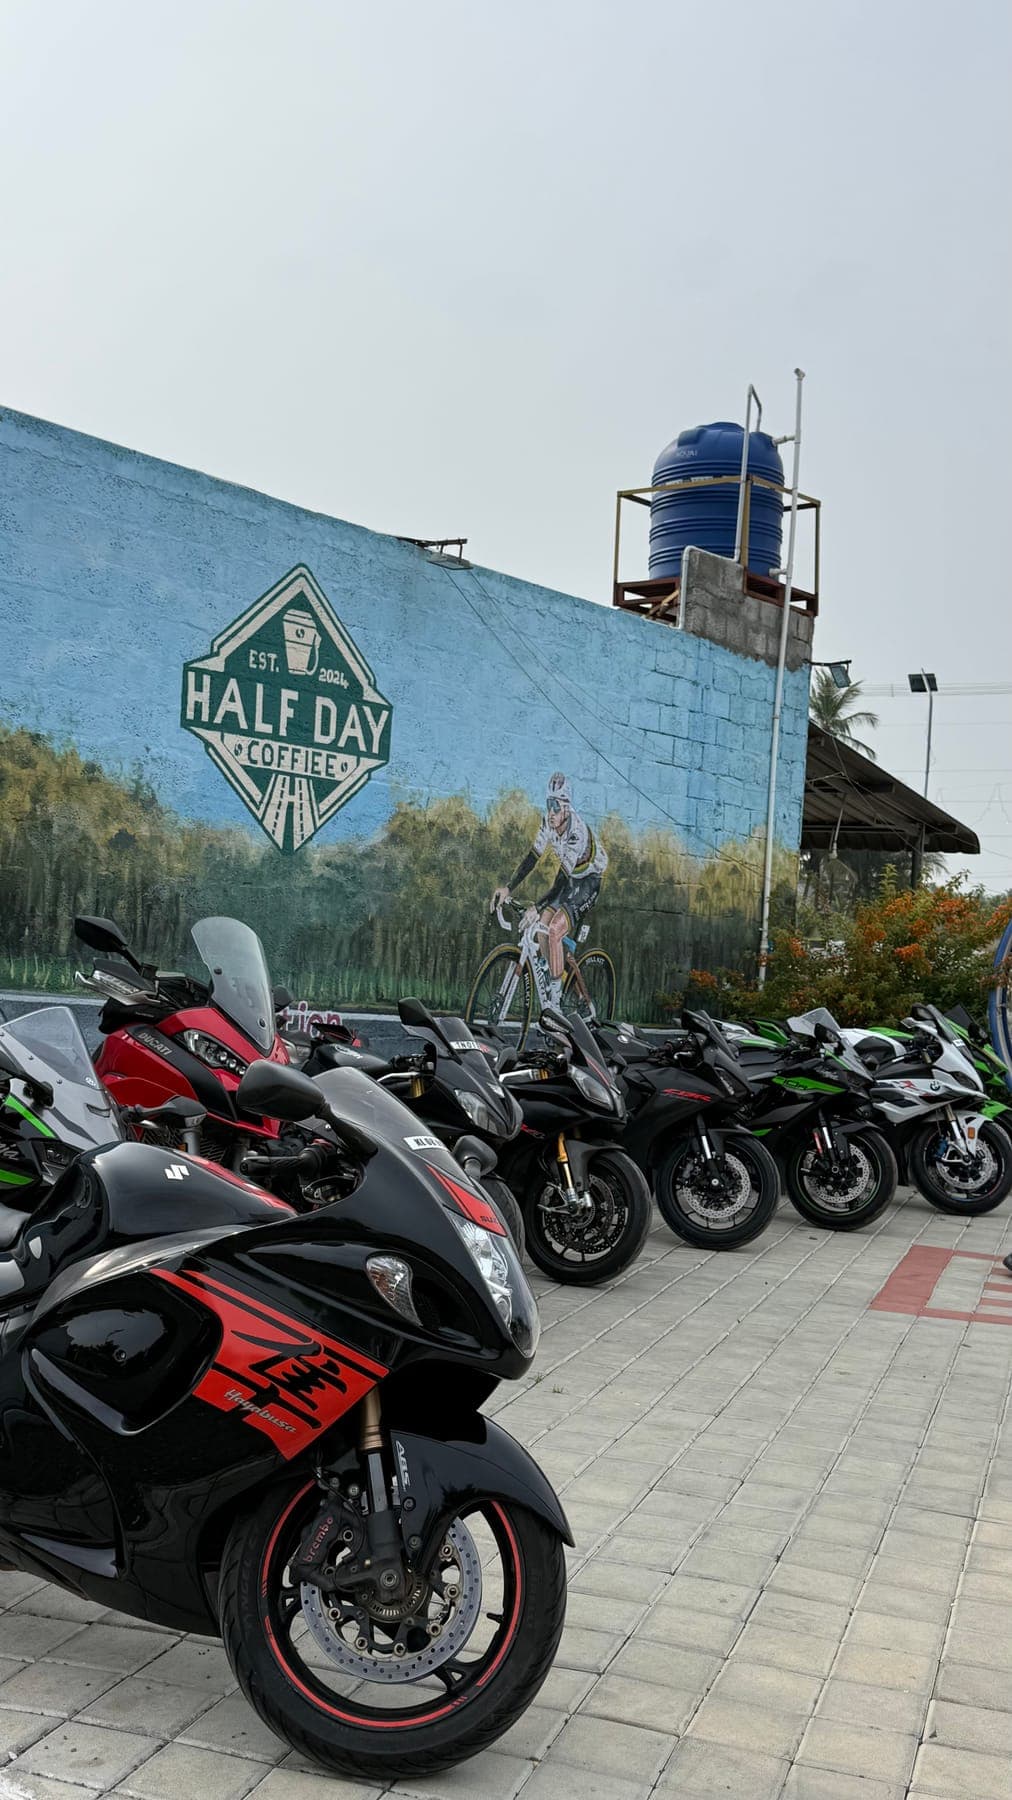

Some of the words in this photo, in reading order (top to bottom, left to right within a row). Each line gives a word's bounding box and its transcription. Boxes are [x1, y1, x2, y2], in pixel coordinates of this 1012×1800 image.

[249, 649, 280, 673] EST.
[318, 667, 349, 689] 2024
[186, 671, 299, 736] HALF
[313, 696, 389, 754] DAY
[247, 740, 338, 778] COFFIEE
[137, 1032, 173, 1055] DUCATI
[223, 1388, 298, 1434] Hayabusa
[395, 1439, 411, 1493] ABS
[304, 1516, 334, 1562] brembo
